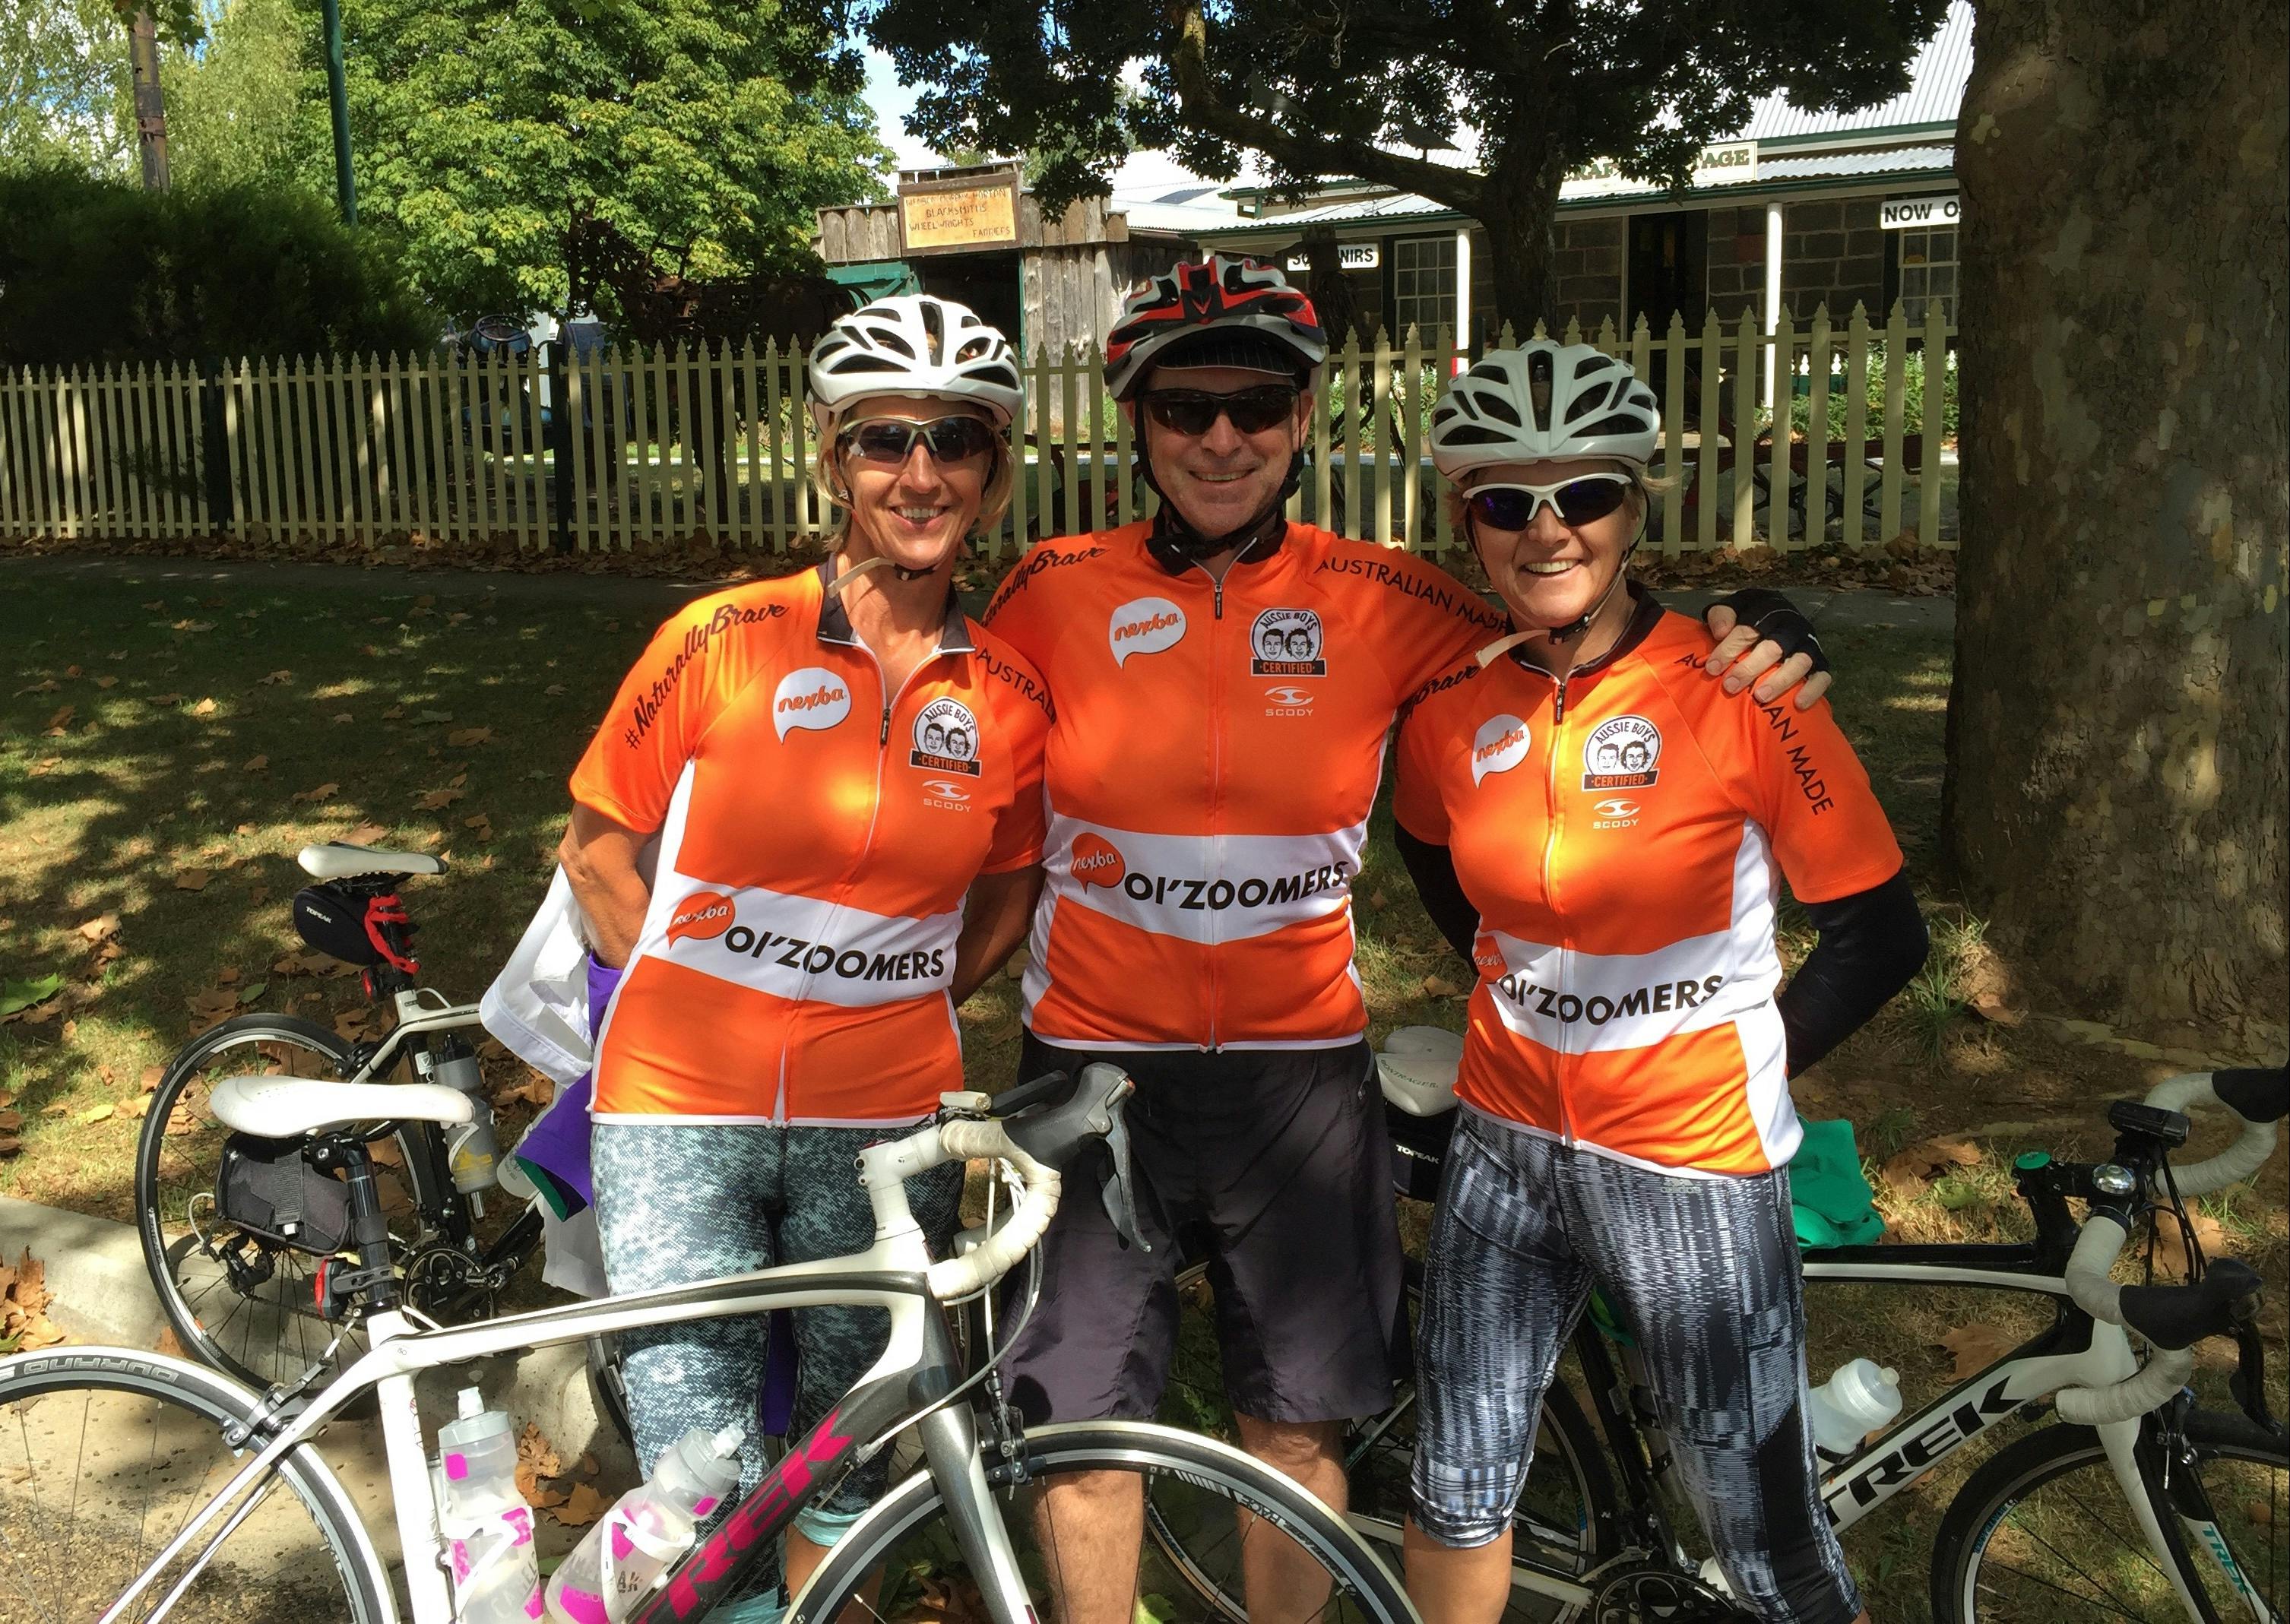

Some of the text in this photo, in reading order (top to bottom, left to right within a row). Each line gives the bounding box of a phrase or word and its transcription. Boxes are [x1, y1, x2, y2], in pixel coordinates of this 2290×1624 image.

[1884, 203, 1933, 223] NOW
[1313, 556, 1453, 613] AUSTRALIAN
[1114, 613, 1179, 641] nexba
[1259, 612, 1317, 632] AUSSIE BOYS
[625, 604, 790, 750] #NaturallyBrave
[1262, 661, 1313, 673] CERTIFIED
[976, 647, 1056, 725] AUSTRAL
[778, 685, 845, 713] nexba
[924, 704, 974, 733] AUSSIE BOYS
[1265, 708, 1314, 717] SCODY
[1595, 721, 1655, 745] AUSSIE BOYS
[920, 755, 969, 772] CERTIFIED
[1594, 774, 1645, 787] CERTIFIED
[1786, 745, 1834, 815] MADE
[923, 798, 972, 812] SCODY
[1592, 818, 1639, 829] SCODY
[1072, 849, 1117, 872] nexba
[1395, 1143, 1440, 1164] TOPEAK
[1822, 1374, 2027, 1527] TREK
[637, 1407, 854, 1624] REK
[2202, 1524, 2253, 1594] TREK
